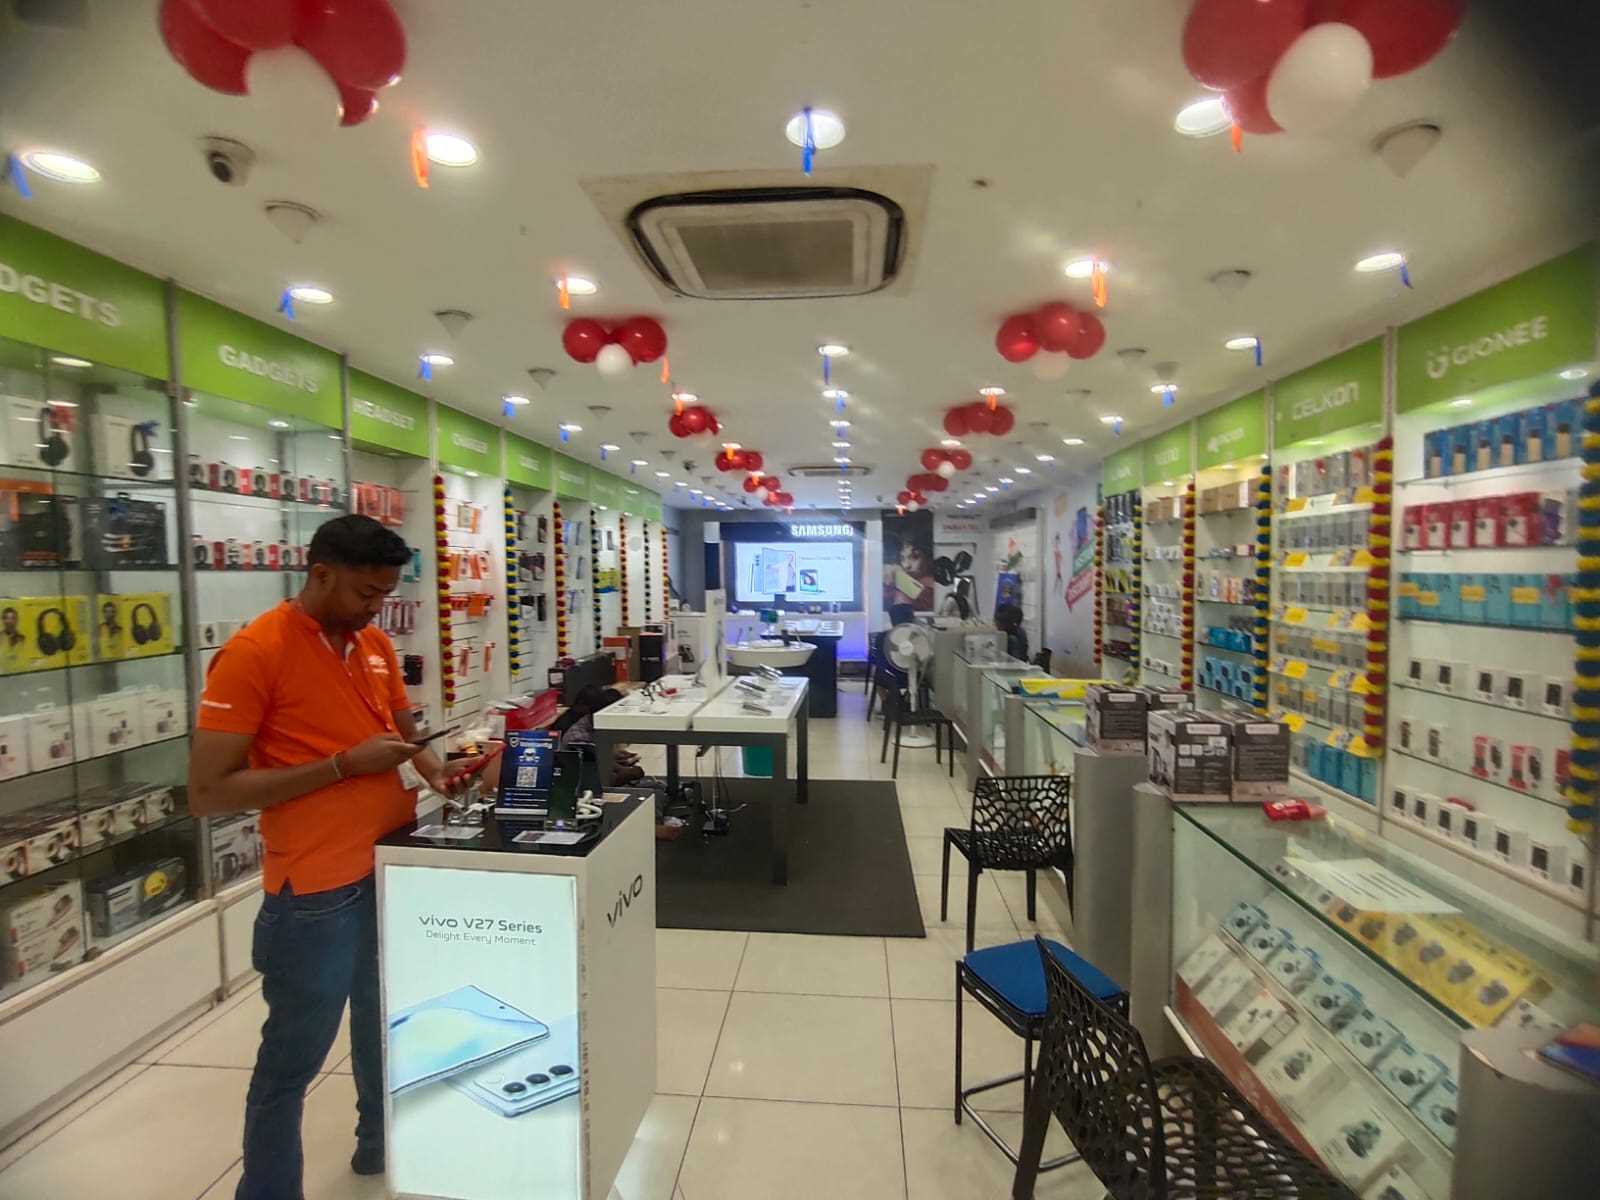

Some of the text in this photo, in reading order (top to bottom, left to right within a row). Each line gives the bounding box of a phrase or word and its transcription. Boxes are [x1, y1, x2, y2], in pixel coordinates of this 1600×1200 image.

[1452, 314, 1549, 366] GIONEE
[217, 343, 320, 393] GADGETS
[790, 523, 854, 537] SAMSUNG
[606, 873, 644, 928] vivo
[418, 914, 543, 935] vivo V27 Series
[426, 929, 536, 946] Delight Every Moment
